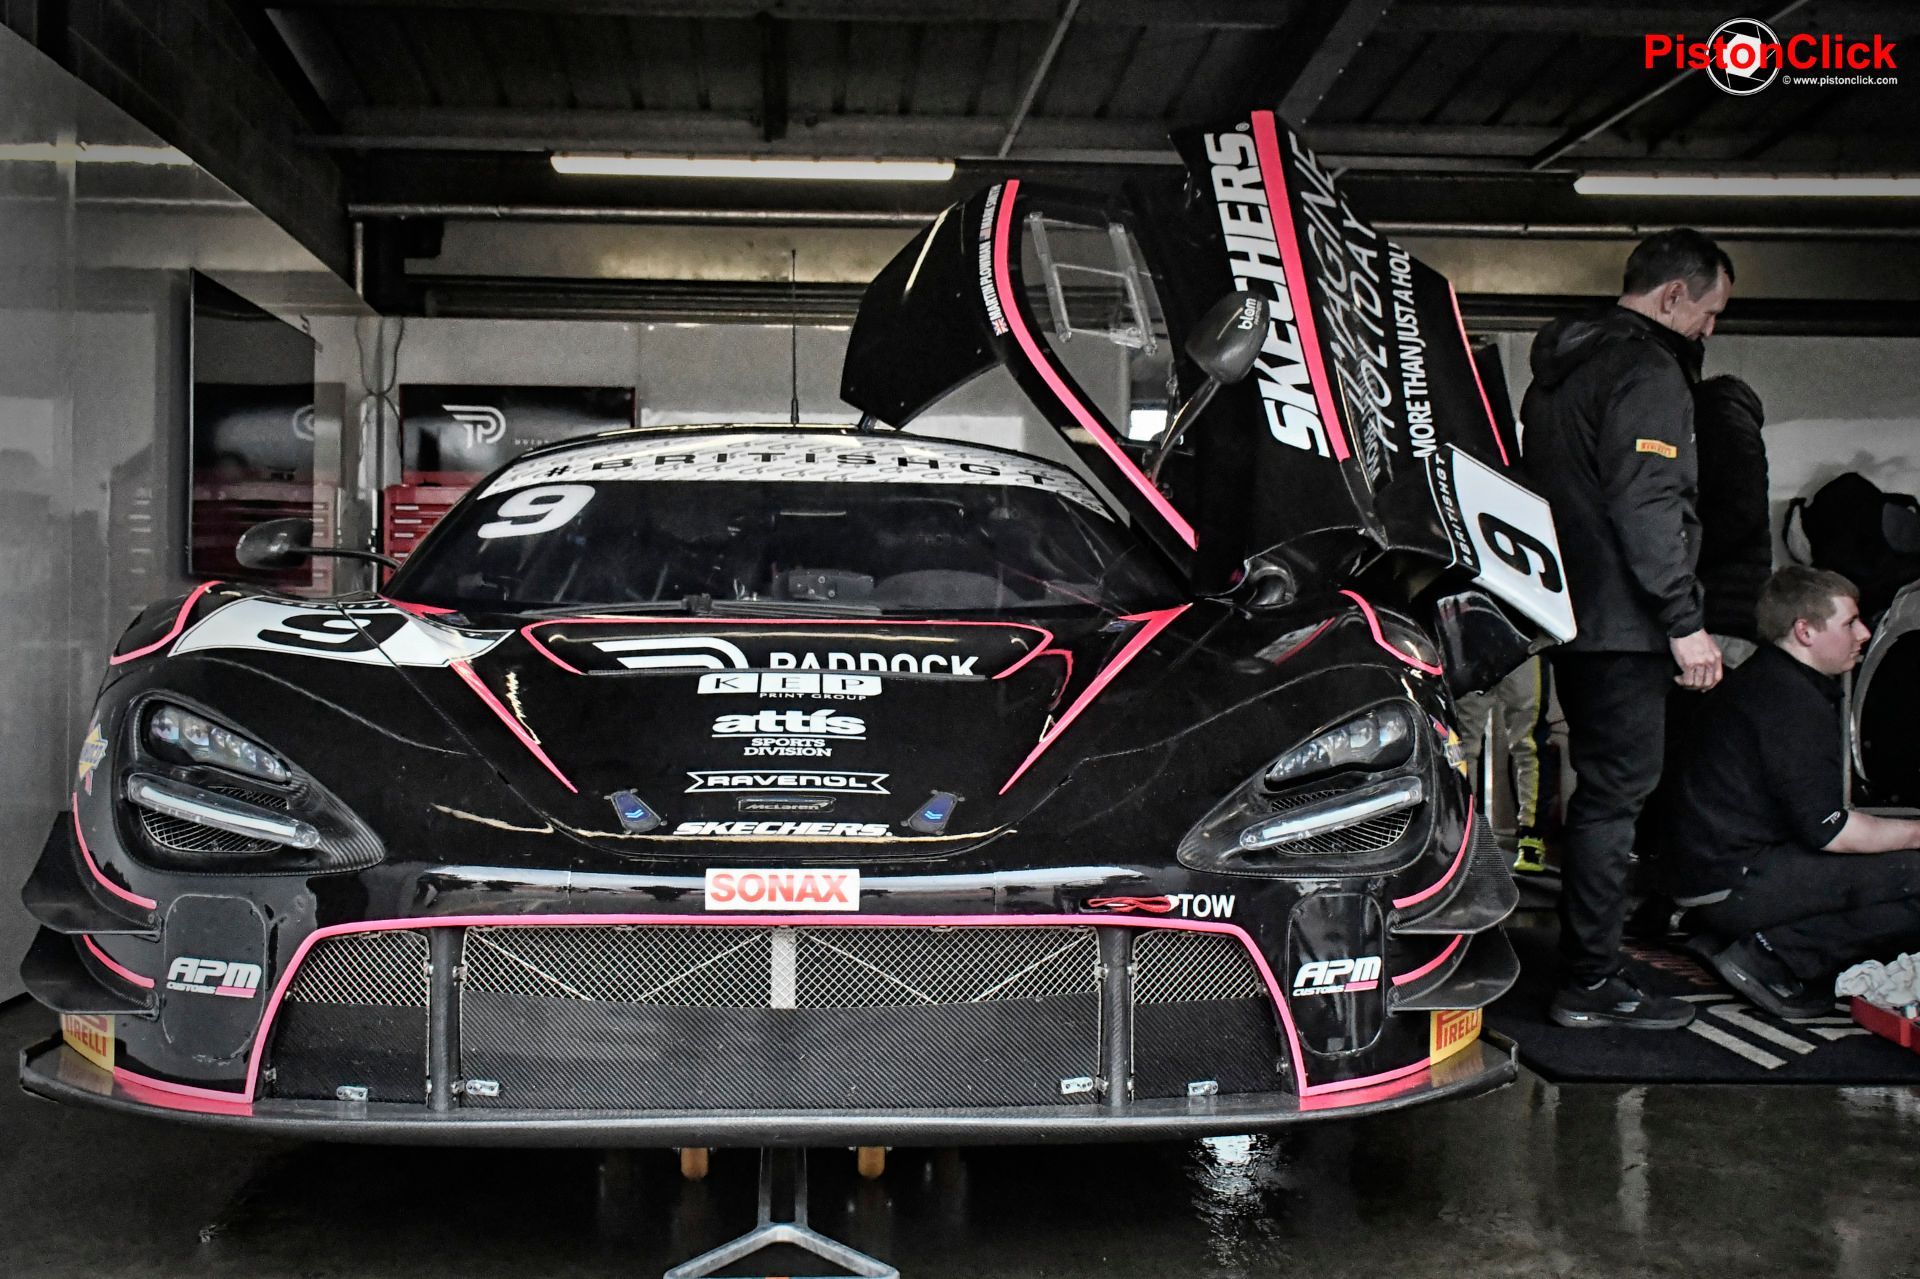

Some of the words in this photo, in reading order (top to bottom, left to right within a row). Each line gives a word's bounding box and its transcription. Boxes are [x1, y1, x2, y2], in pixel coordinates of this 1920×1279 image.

[978, 240, 992, 285] PLOWMAN
[980, 285, 1003, 321] MARTIN
[1339, 189, 1400, 452] HOLIDAY
[1393, 301, 1427, 350] JUST
[1399, 345, 1429, 398] THAN
[1405, 400, 1438, 458] MORE
[477, 484, 596, 539] 9
[1477, 512, 1563, 594] 9
[257, 612, 410, 653] 9
[811, 693, 867, 701] GROUP
[743, 746, 833, 758] DIVISION
[751, 737, 826, 747] SPORTS
[706, 775, 868, 788] RAVENOL
[709, 873, 849, 903] SONAX
[1177, 893, 1236, 918] TOW
[167, 956, 263, 989] APM
[1292, 955, 1382, 988] APM
